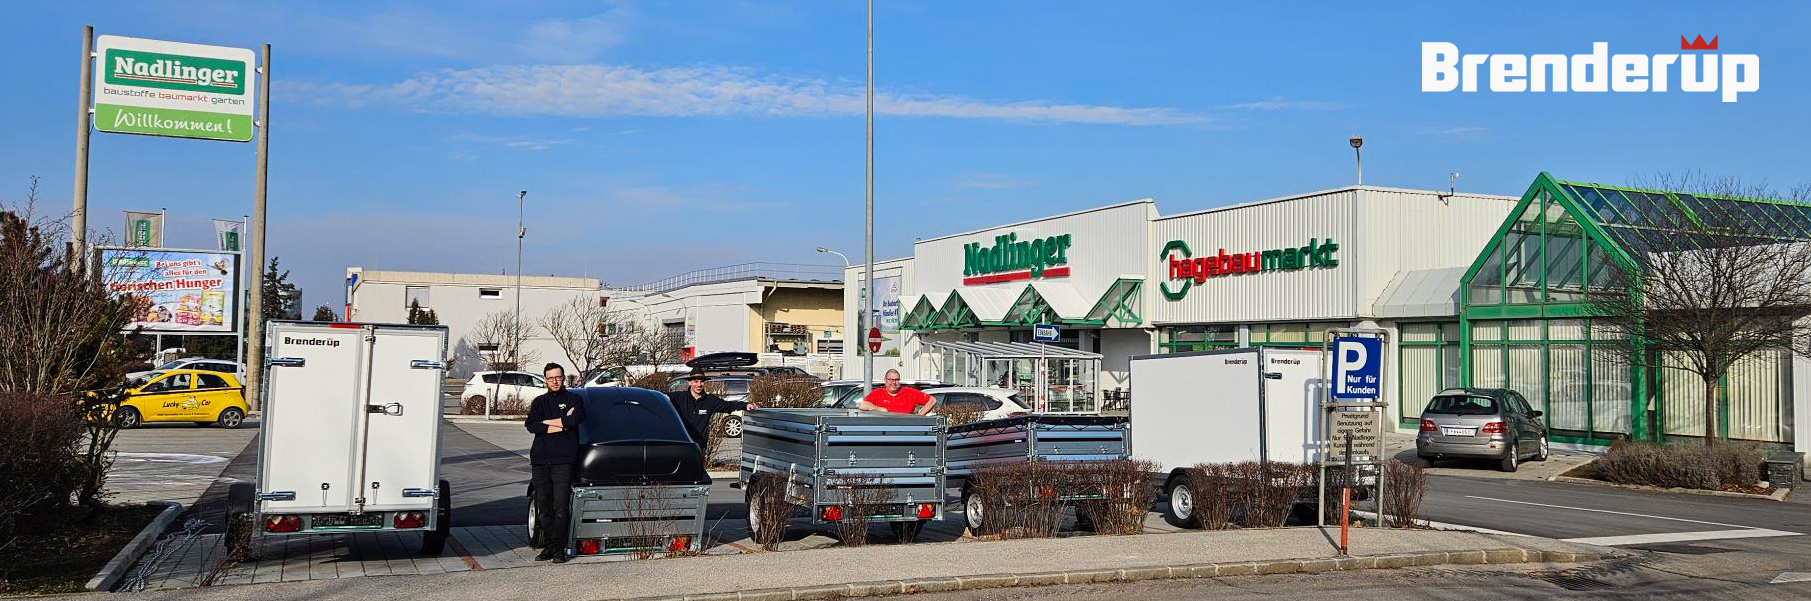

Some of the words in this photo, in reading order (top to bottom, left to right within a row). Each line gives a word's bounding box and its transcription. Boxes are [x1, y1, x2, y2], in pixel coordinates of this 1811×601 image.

[114, 56, 239, 86] Nadlinger
[104, 87, 156, 98] baustoffe
[158, 92, 208, 103] baumarkt
[211, 96, 245, 105] garten
[114, 109, 233, 134] Willkommen!
[963, 232, 1071, 278] Nadlinger
[1169, 238, 1339, 283] hagebaumarkt
[182, 260, 201, 269] gibt's
[165, 269, 181, 277] alles
[177, 278, 222, 290] Hunger
[1336, 341, 1367, 394] P
[1347, 375, 1361, 383] Nur
[1365, 374, 1377, 383] für
[1346, 385, 1376, 394] Kunden
[163, 400, 180, 409] Lucky
